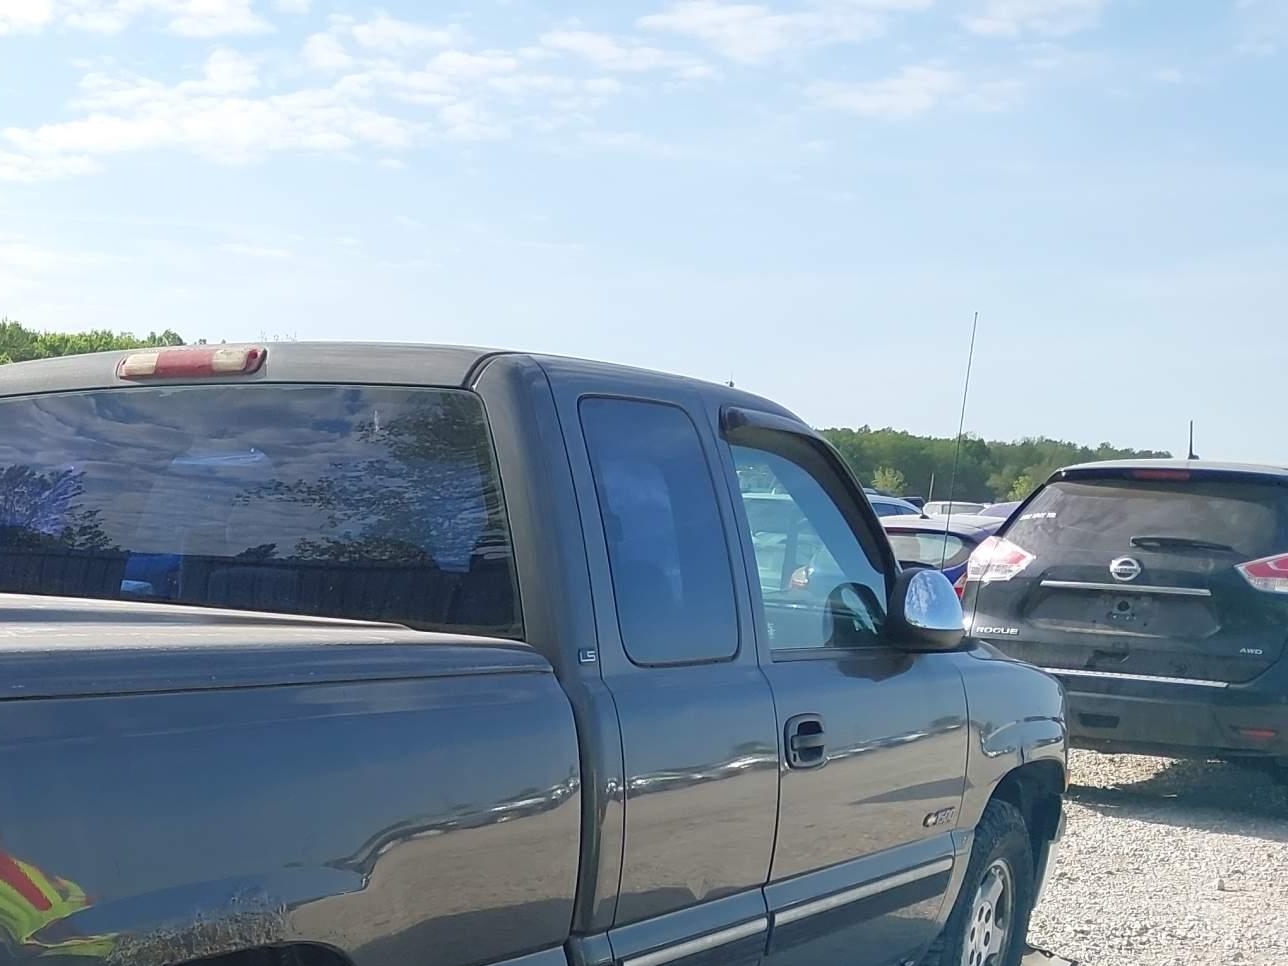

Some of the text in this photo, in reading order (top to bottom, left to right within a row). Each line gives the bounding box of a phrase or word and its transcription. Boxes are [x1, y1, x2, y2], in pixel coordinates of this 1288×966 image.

[976, 626, 1019, 635] ROGUE
[1239, 647, 1263, 655] AWD
[579, 651, 596, 662] LS
